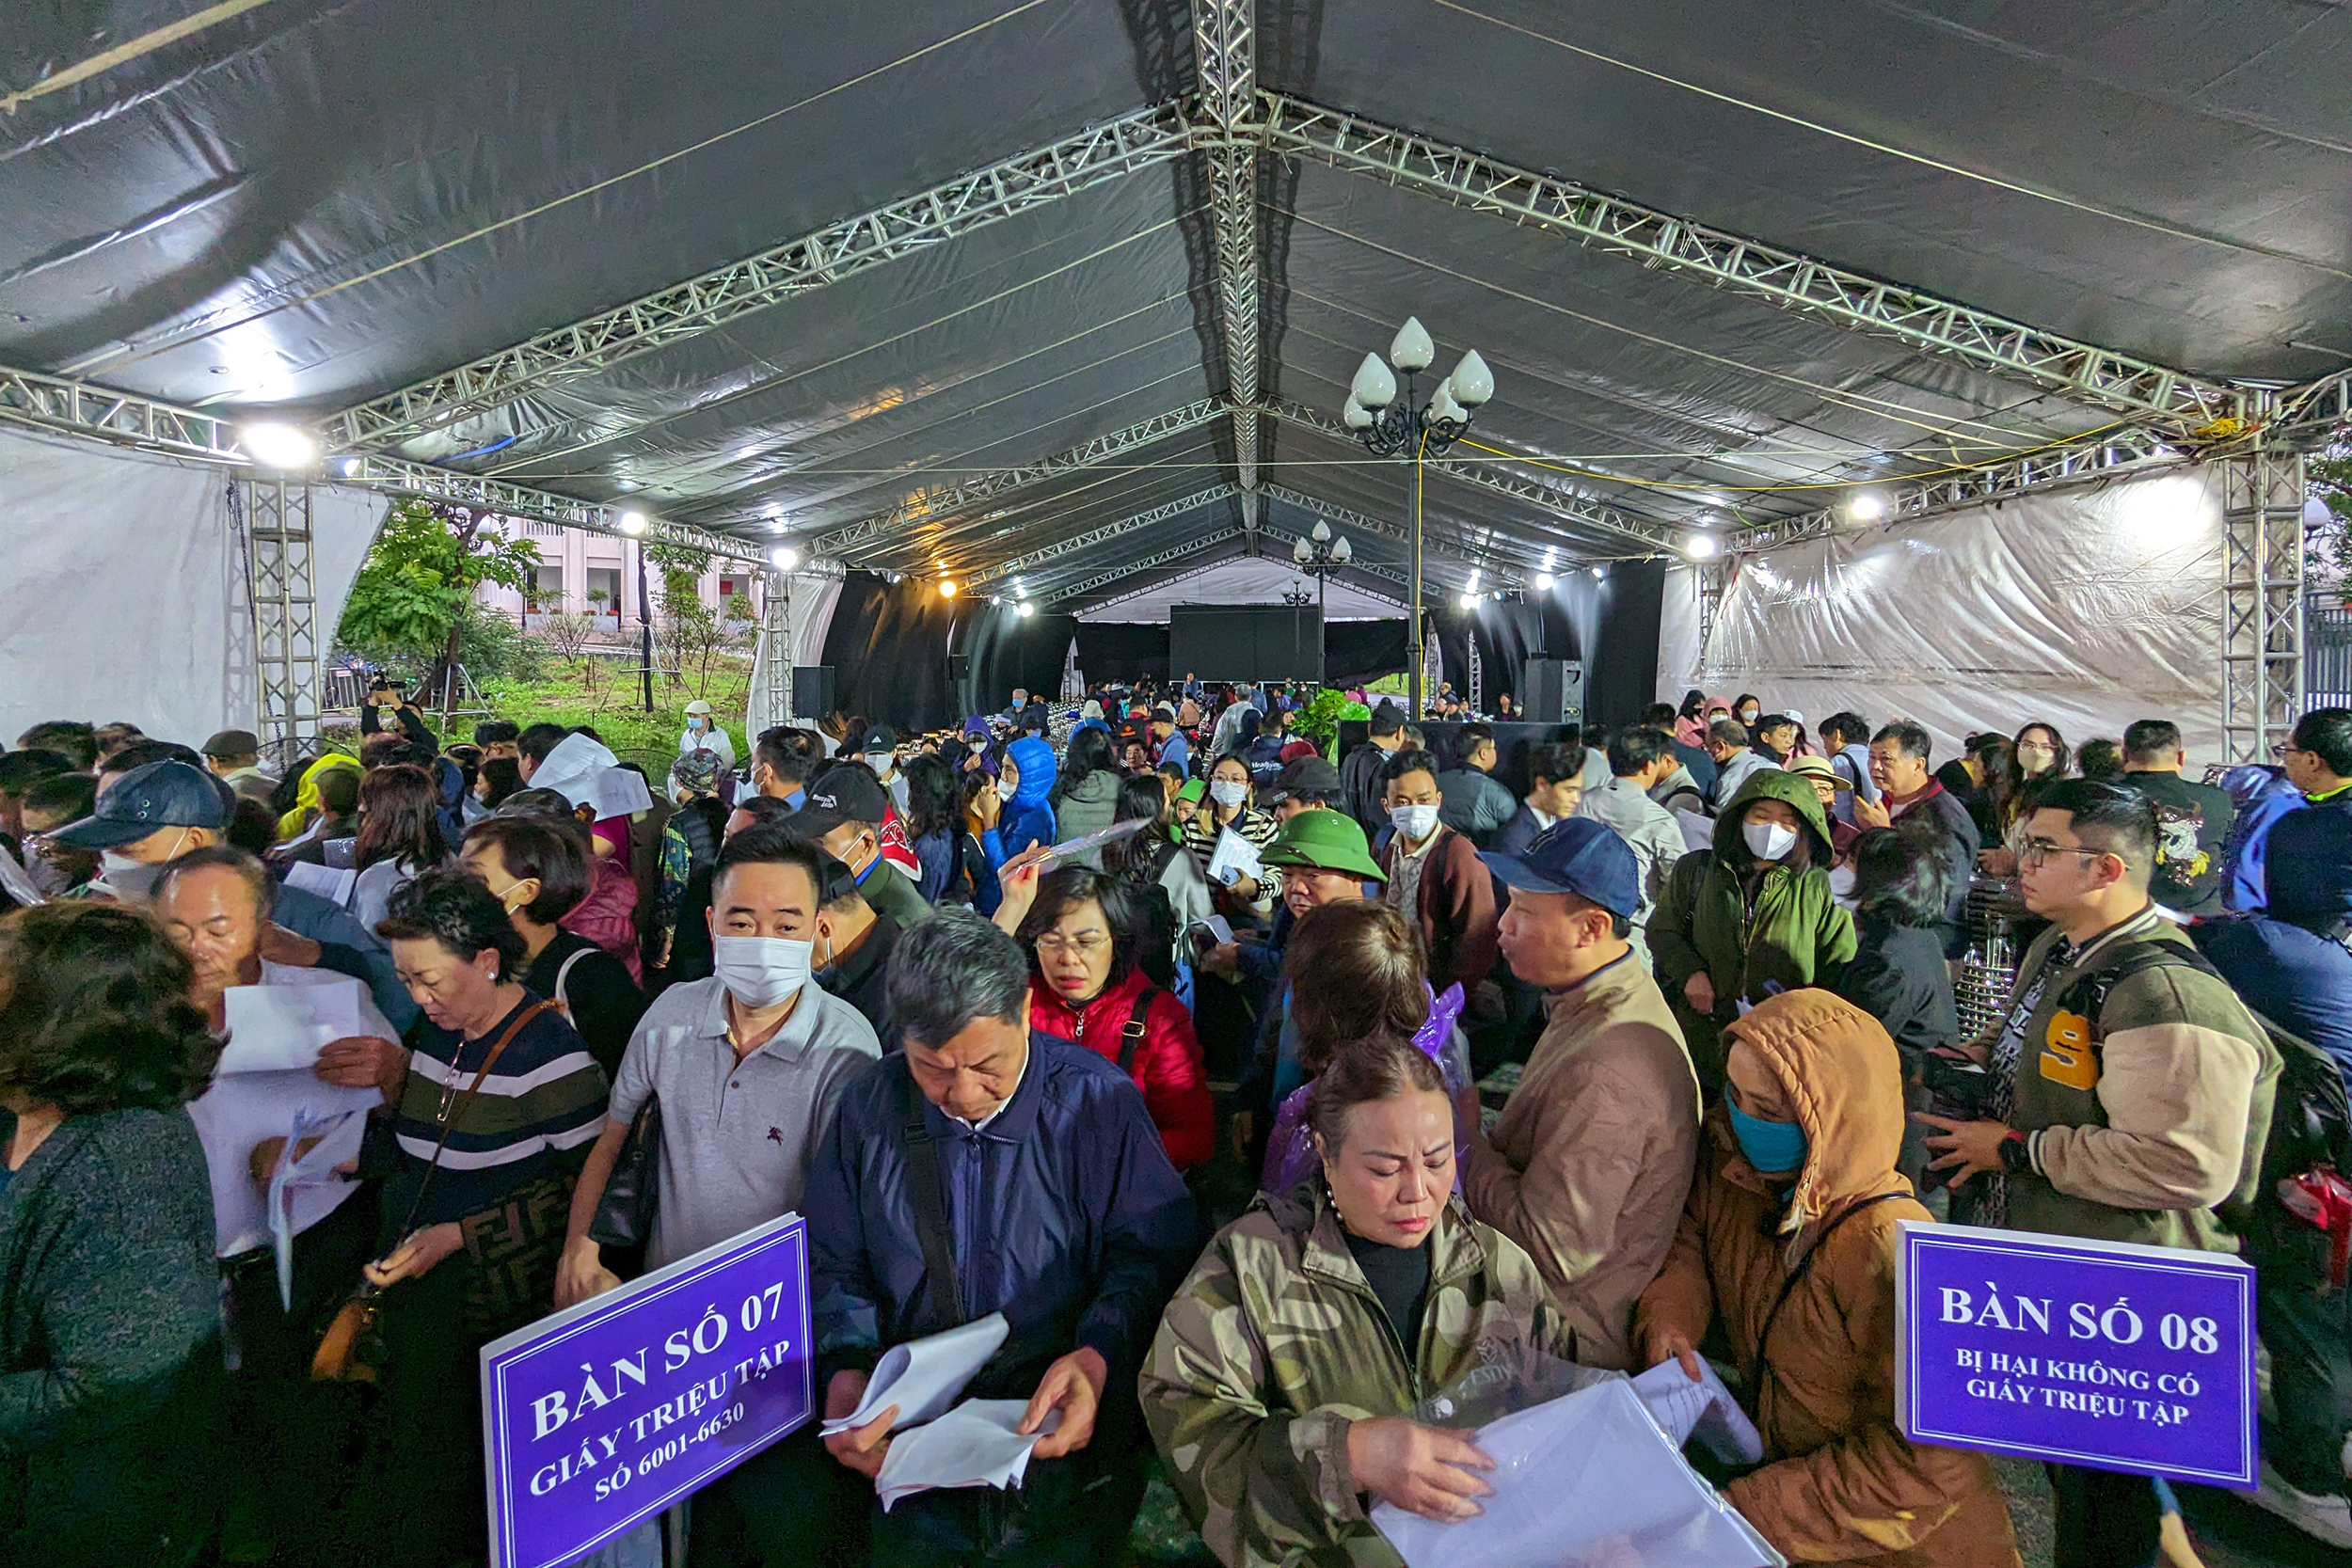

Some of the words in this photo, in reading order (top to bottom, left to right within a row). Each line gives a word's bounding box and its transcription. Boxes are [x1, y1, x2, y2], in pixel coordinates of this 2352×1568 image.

[1938, 1280, 2053, 1336] BÀN
[2069, 1296, 2144, 1345] SỐ
[2159, 1312, 2218, 1354] 08
[529, 1347, 649, 1442] BÀN
[664, 1302, 728, 1374] SỐ
[740, 1281, 784, 1332] 07
[1956, 1348, 1983, 1373] BỊ
[1991, 1353, 2039, 1379] HẠI
[2045, 1360, 2150, 1390] KHÔNG
[2157, 1371, 2201, 1397] CÓ
[1966, 1377, 2036, 1403] GIẤY
[2040, 1387, 2125, 1418] TRIỆU
[2132, 1400, 2190, 1427] TẬP
[530, 1428, 624, 1497] GIẤY
[629, 1372, 728, 1444] TRIỆU
[735, 1339, 790, 1386] TẬP
[596, 1462, 631, 1502] SỐ
[638, 1402, 745, 1477] 6001-6630
